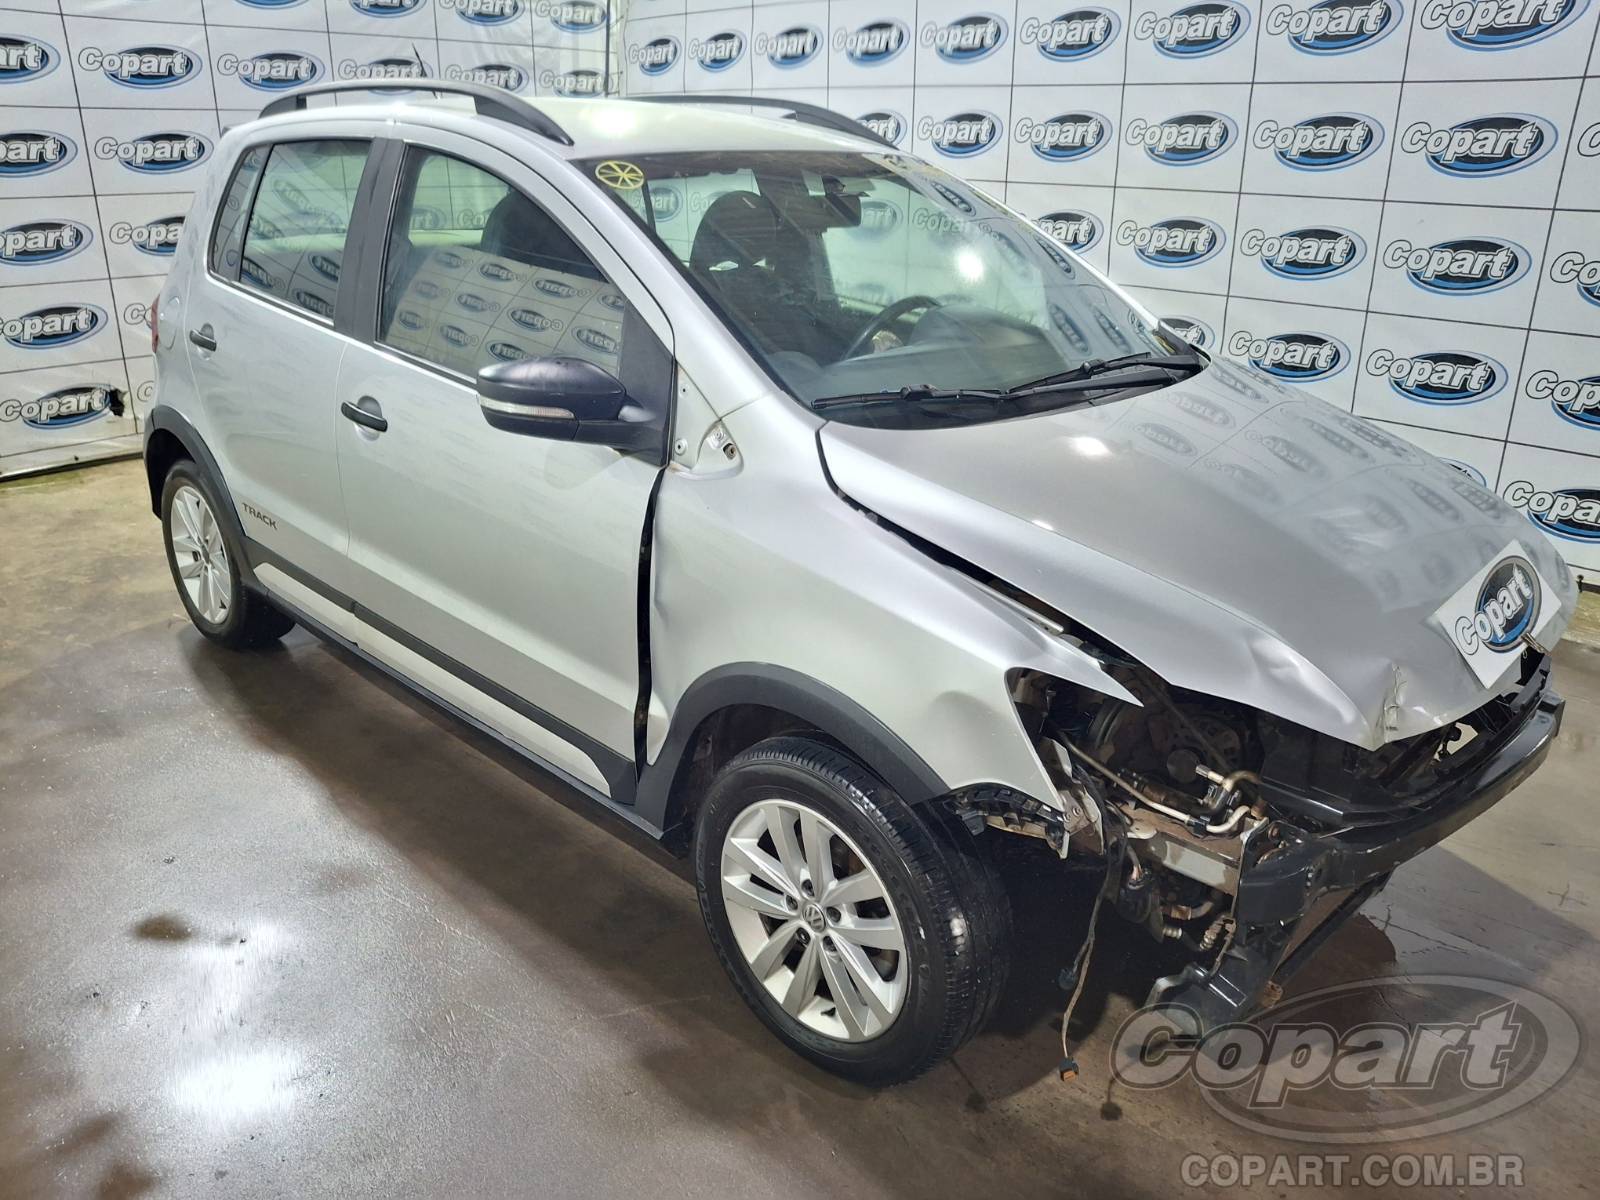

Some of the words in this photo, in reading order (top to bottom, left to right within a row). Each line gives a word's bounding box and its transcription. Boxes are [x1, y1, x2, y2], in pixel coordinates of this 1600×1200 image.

[536, 0, 601, 25] Copart
[1134, 7, 1237, 48] Copart
[1266, 0, 1385, 41] Copart
[1421, 0, 1566, 37] Copart
[755, 28, 817, 61] Copart
[833, 23, 903, 57] Copart
[921, 19, 997, 54] Copart
[1020, 14, 1109, 52] Copart
[79, 47, 187, 78] Copart
[218, 54, 312, 80] Copart
[629, 42, 675, 69] Copart
[688, 37, 739, 65] Copart
[338, 59, 422, 80] Copart
[445, 64, 518, 90] Copart
[540, 69, 601, 96] Copart
[917, 115, 993, 147] Copart
[1015, 117, 1100, 151] Copart
[1126, 118, 1225, 154] Copart
[1253, 120, 1367, 158] Copart
[1401, 122, 1537, 163] Copart
[95, 137, 197, 166] Copart
[0, 224, 76, 258] part
[109, 221, 183, 249] Copa
[1116, 220, 1212, 255] Copart
[1241, 229, 1352, 266] Copart
[1383, 240, 1513, 281] Copart
[0, 308, 91, 342] opart
[1229, 331, 1339, 371] Copart
[1366, 349, 1490, 393] Copart
[0, 390, 106, 424] Copart
[1525, 370, 1600, 414] Cop
[241, 502, 278, 531] TRACK
[1503, 480, 1600, 524] Copa
[1454, 561, 1533, 656] Copart
